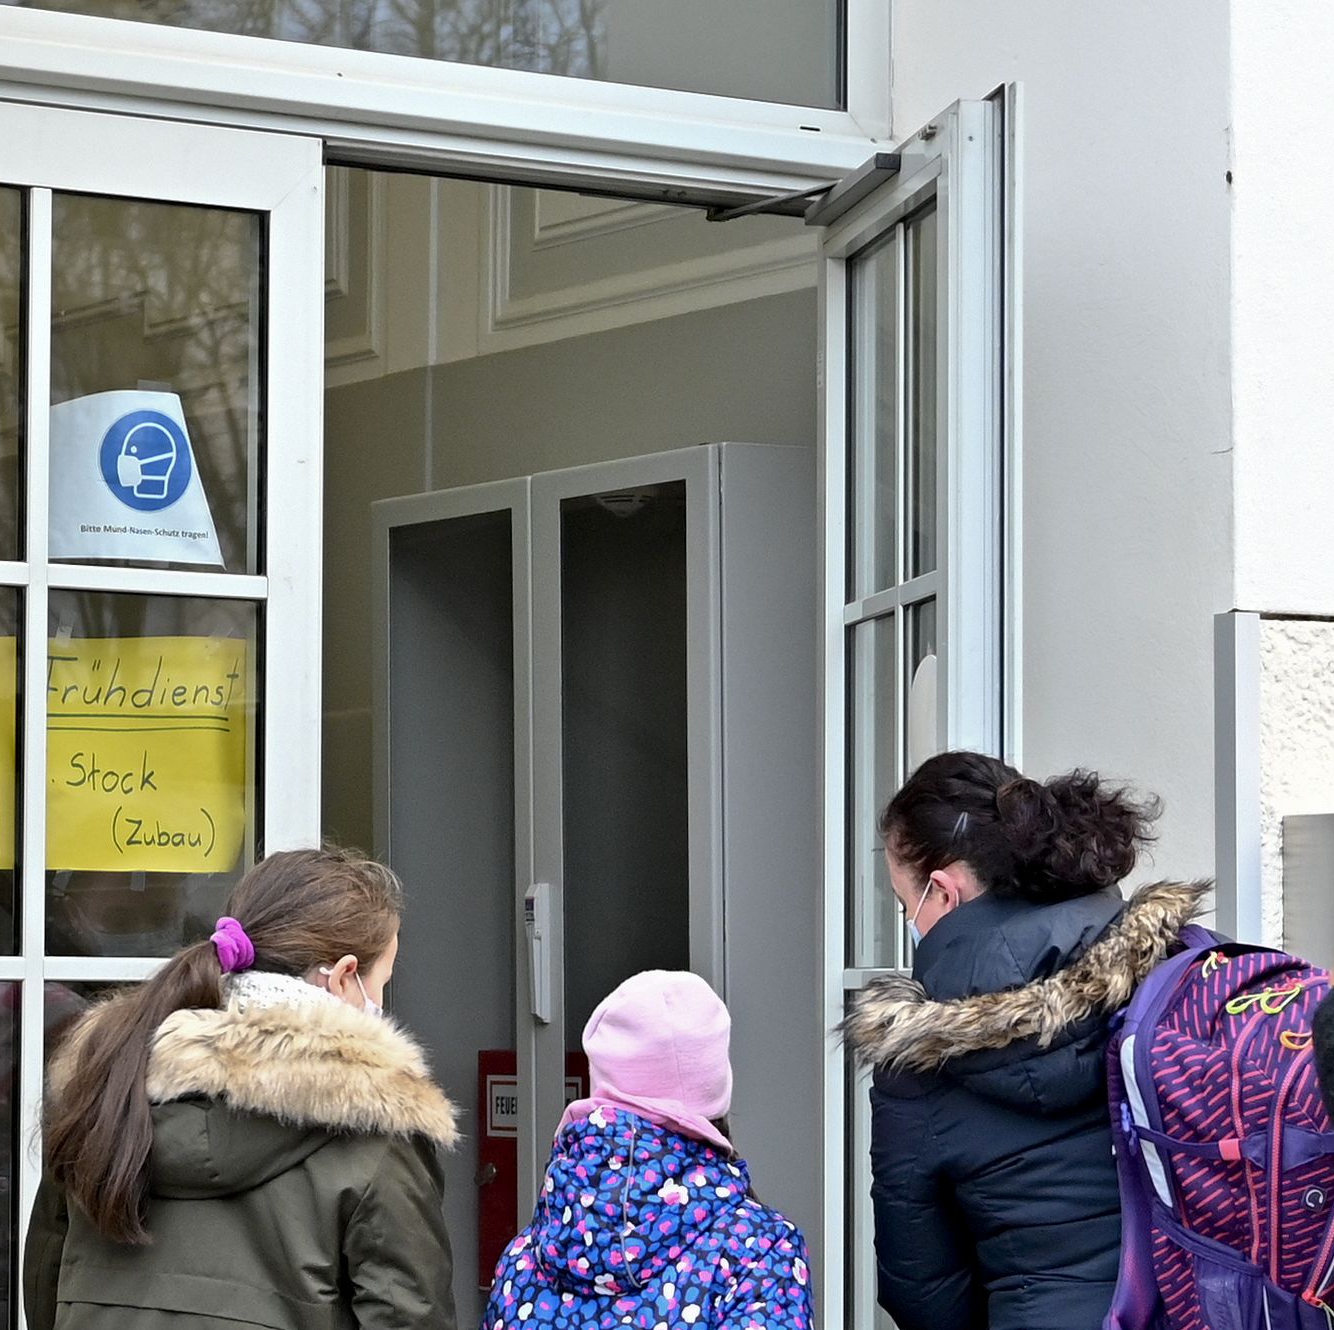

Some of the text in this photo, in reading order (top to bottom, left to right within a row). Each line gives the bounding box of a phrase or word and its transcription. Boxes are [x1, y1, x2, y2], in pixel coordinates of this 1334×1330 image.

[80, 524, 102, 533] Bitte
[181, 530, 209, 540] tragen!
[47, 655, 240, 711] Frühdienst
[65, 751, 158, 795] Stock
[112, 806, 216, 856] (Zubau)
